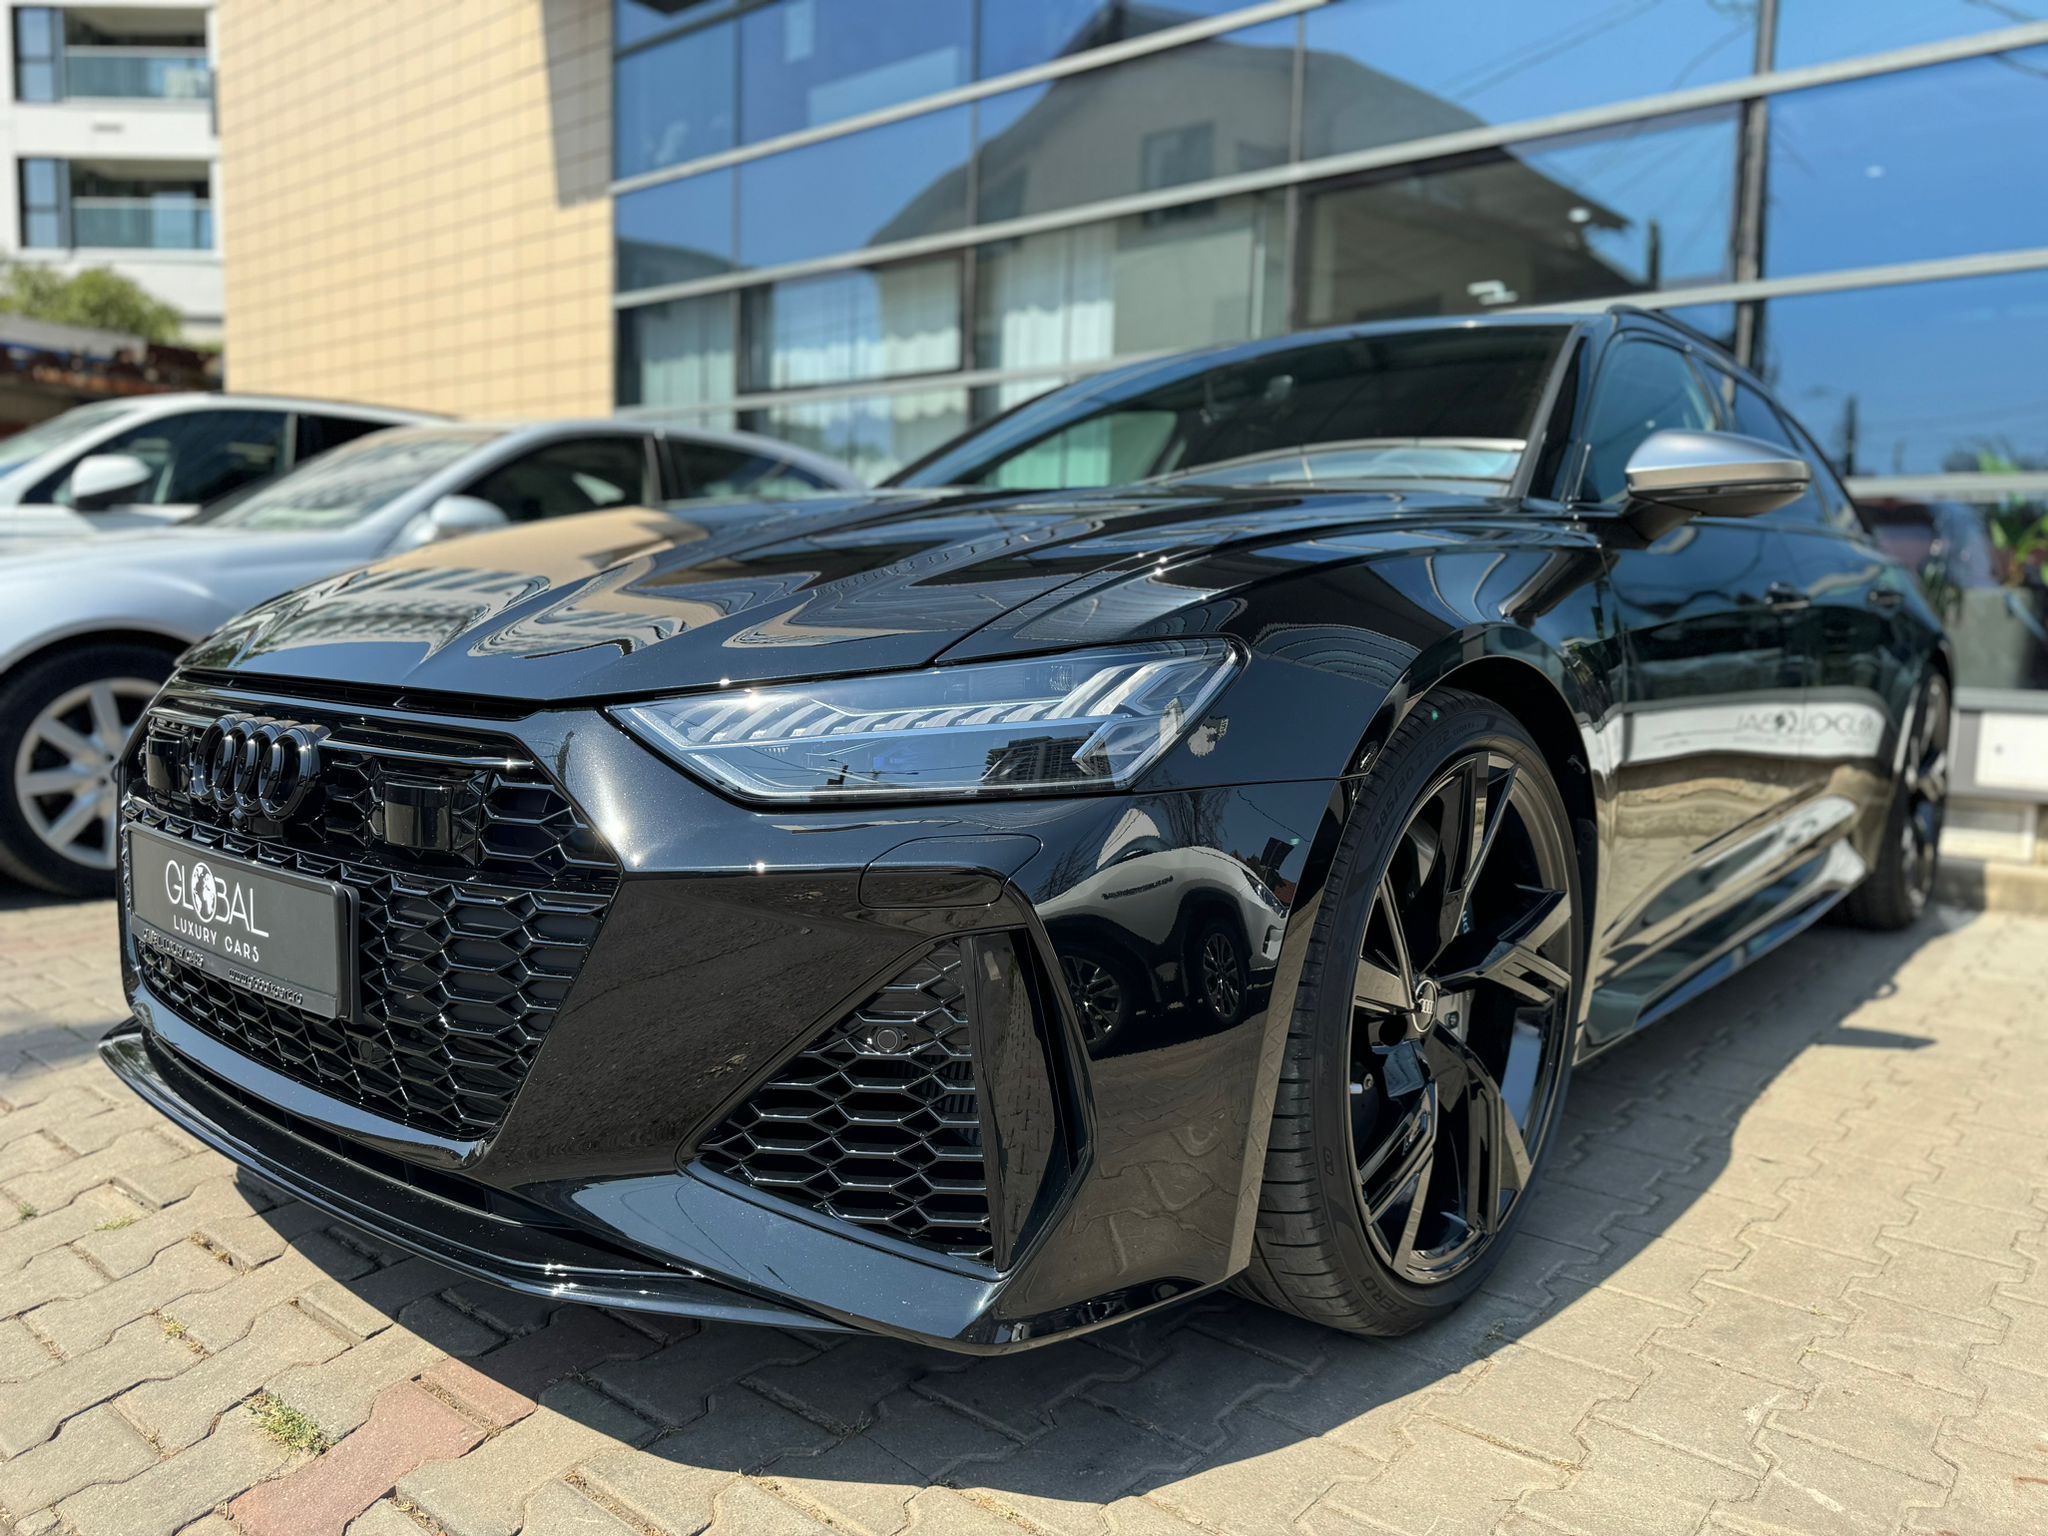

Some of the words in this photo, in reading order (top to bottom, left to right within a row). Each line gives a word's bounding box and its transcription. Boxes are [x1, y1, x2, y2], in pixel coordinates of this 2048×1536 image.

[165, 860, 269, 937] GLOBAL
[173, 914, 217, 945] LUXURY
[224, 936, 259, 962] CARS
[1360, 1276, 1409, 1317] ZERO
